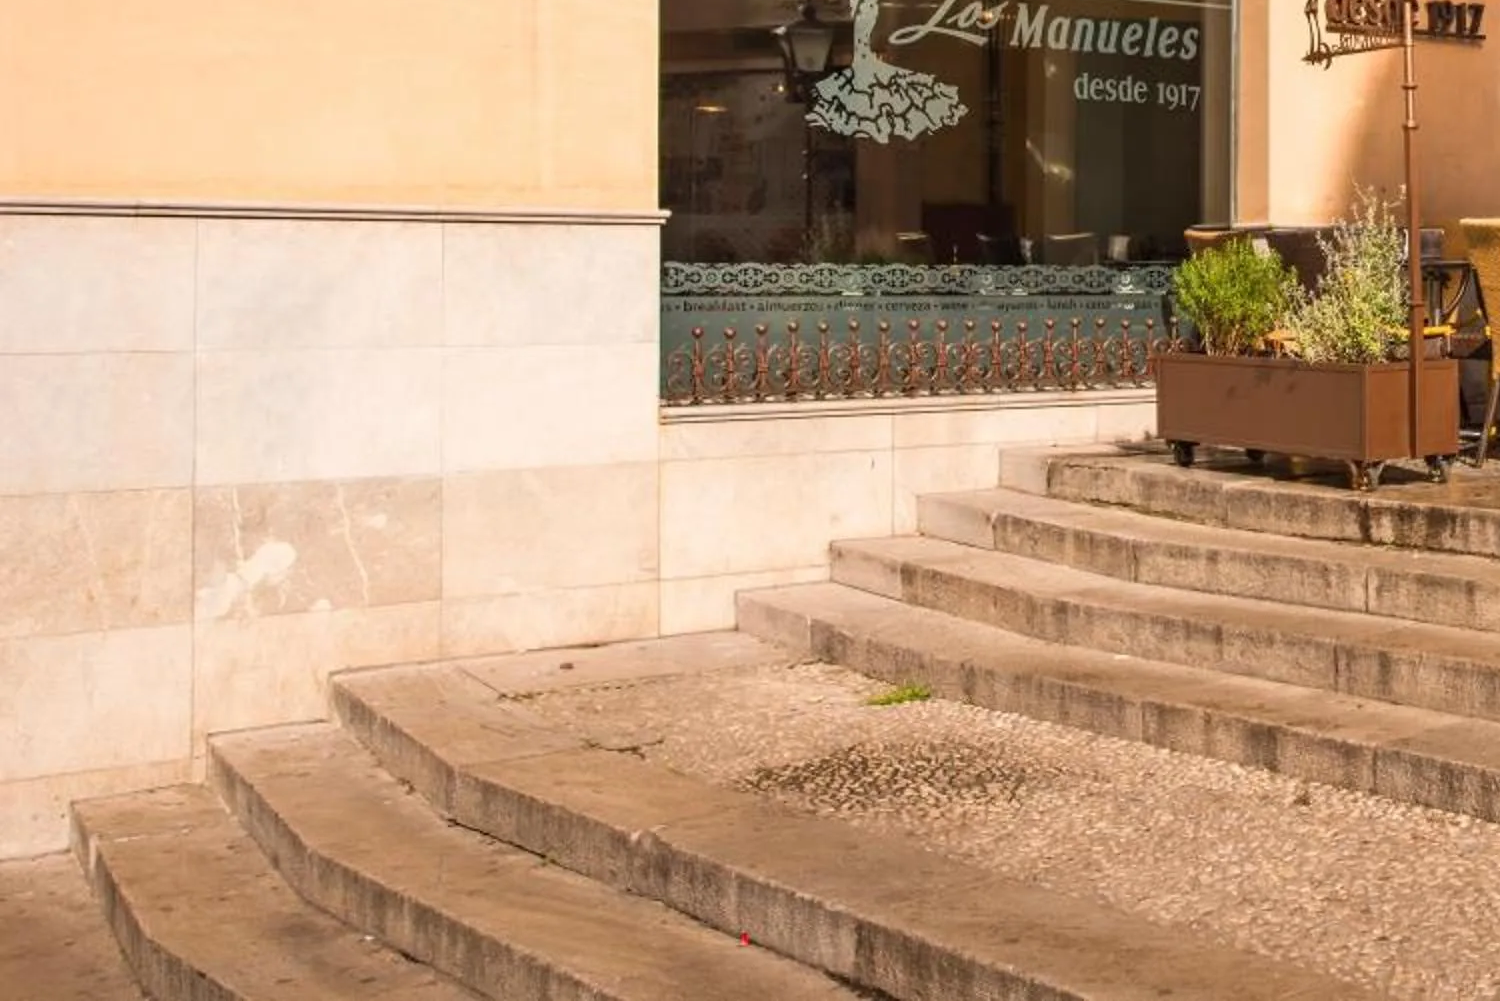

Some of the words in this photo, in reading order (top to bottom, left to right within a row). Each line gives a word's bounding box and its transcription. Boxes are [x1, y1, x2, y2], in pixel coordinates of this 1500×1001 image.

[1009, 3, 1199, 60] Manueles
[1426, 0, 1486, 35] 1917
[1073, 72, 1148, 103] desde
[1157, 82, 1201, 111] 1917
[683, 300, 746, 312] breakfast
[886, 301, 931, 312] cerveza
